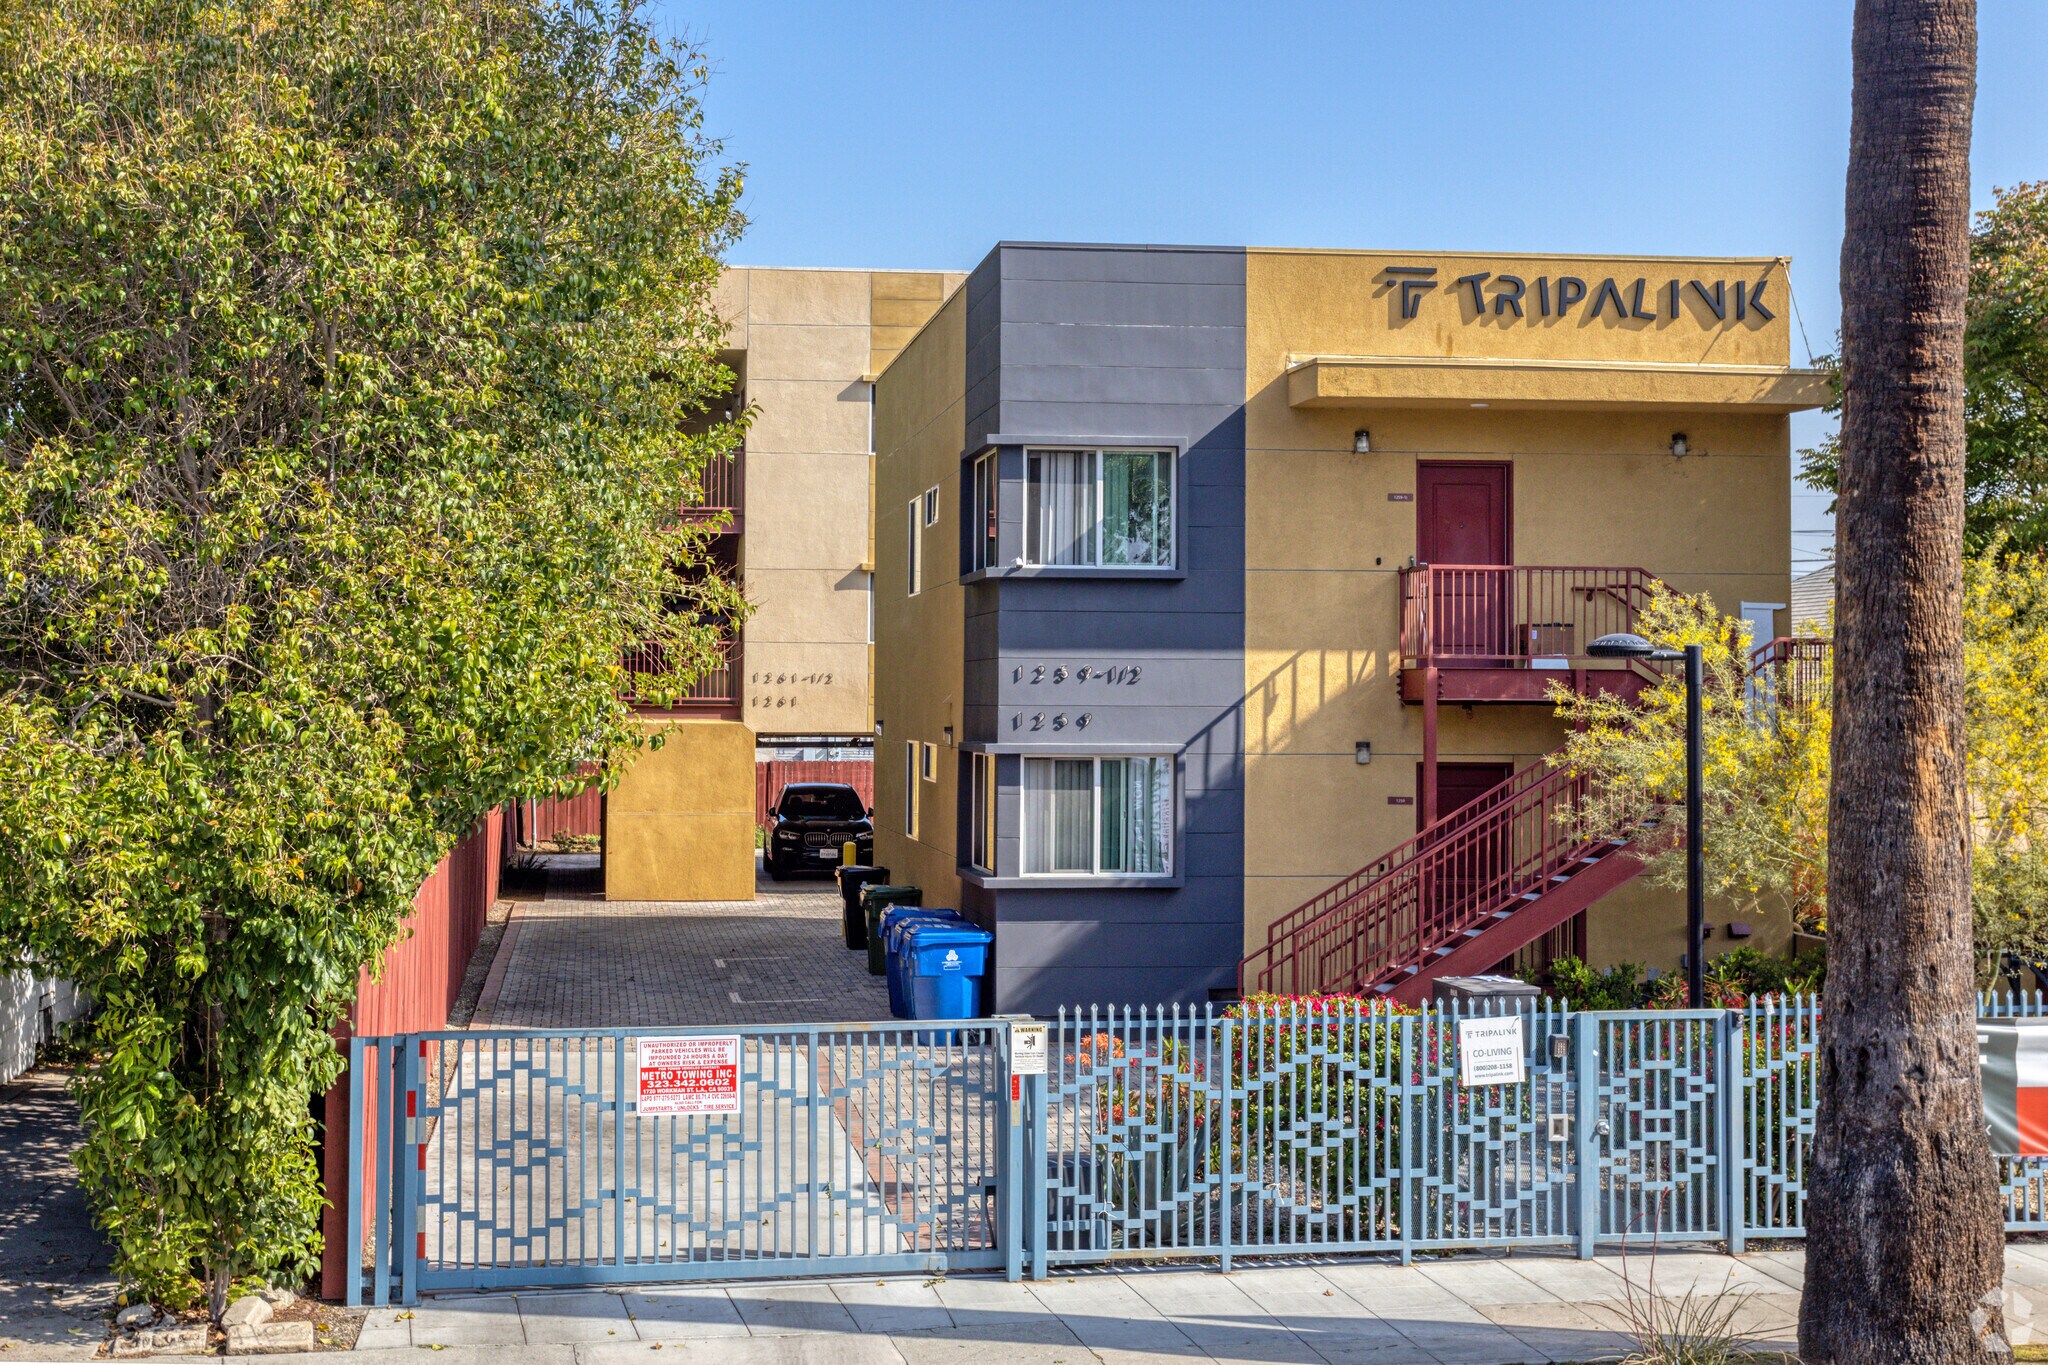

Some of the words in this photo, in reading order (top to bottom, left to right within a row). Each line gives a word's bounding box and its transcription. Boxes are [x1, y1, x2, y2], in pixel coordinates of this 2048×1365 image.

[1459, 272, 1775, 320] TRIPALINK
[752, 672, 833, 685] 1261-1/2
[752, 696, 797, 708] 1261
[1012, 712, 1092, 731] 1259
[1475, 1028, 1517, 1038] TRIPALINK
[1473, 1047, 1512, 1057] CO-LIVING
[642, 1071, 673, 1080] METRO
[676, 1070, 712, 1079] TOWING
[716, 1069, 735, 1078] INC.
[647, 1078, 730, 1088] 323.342.0602
